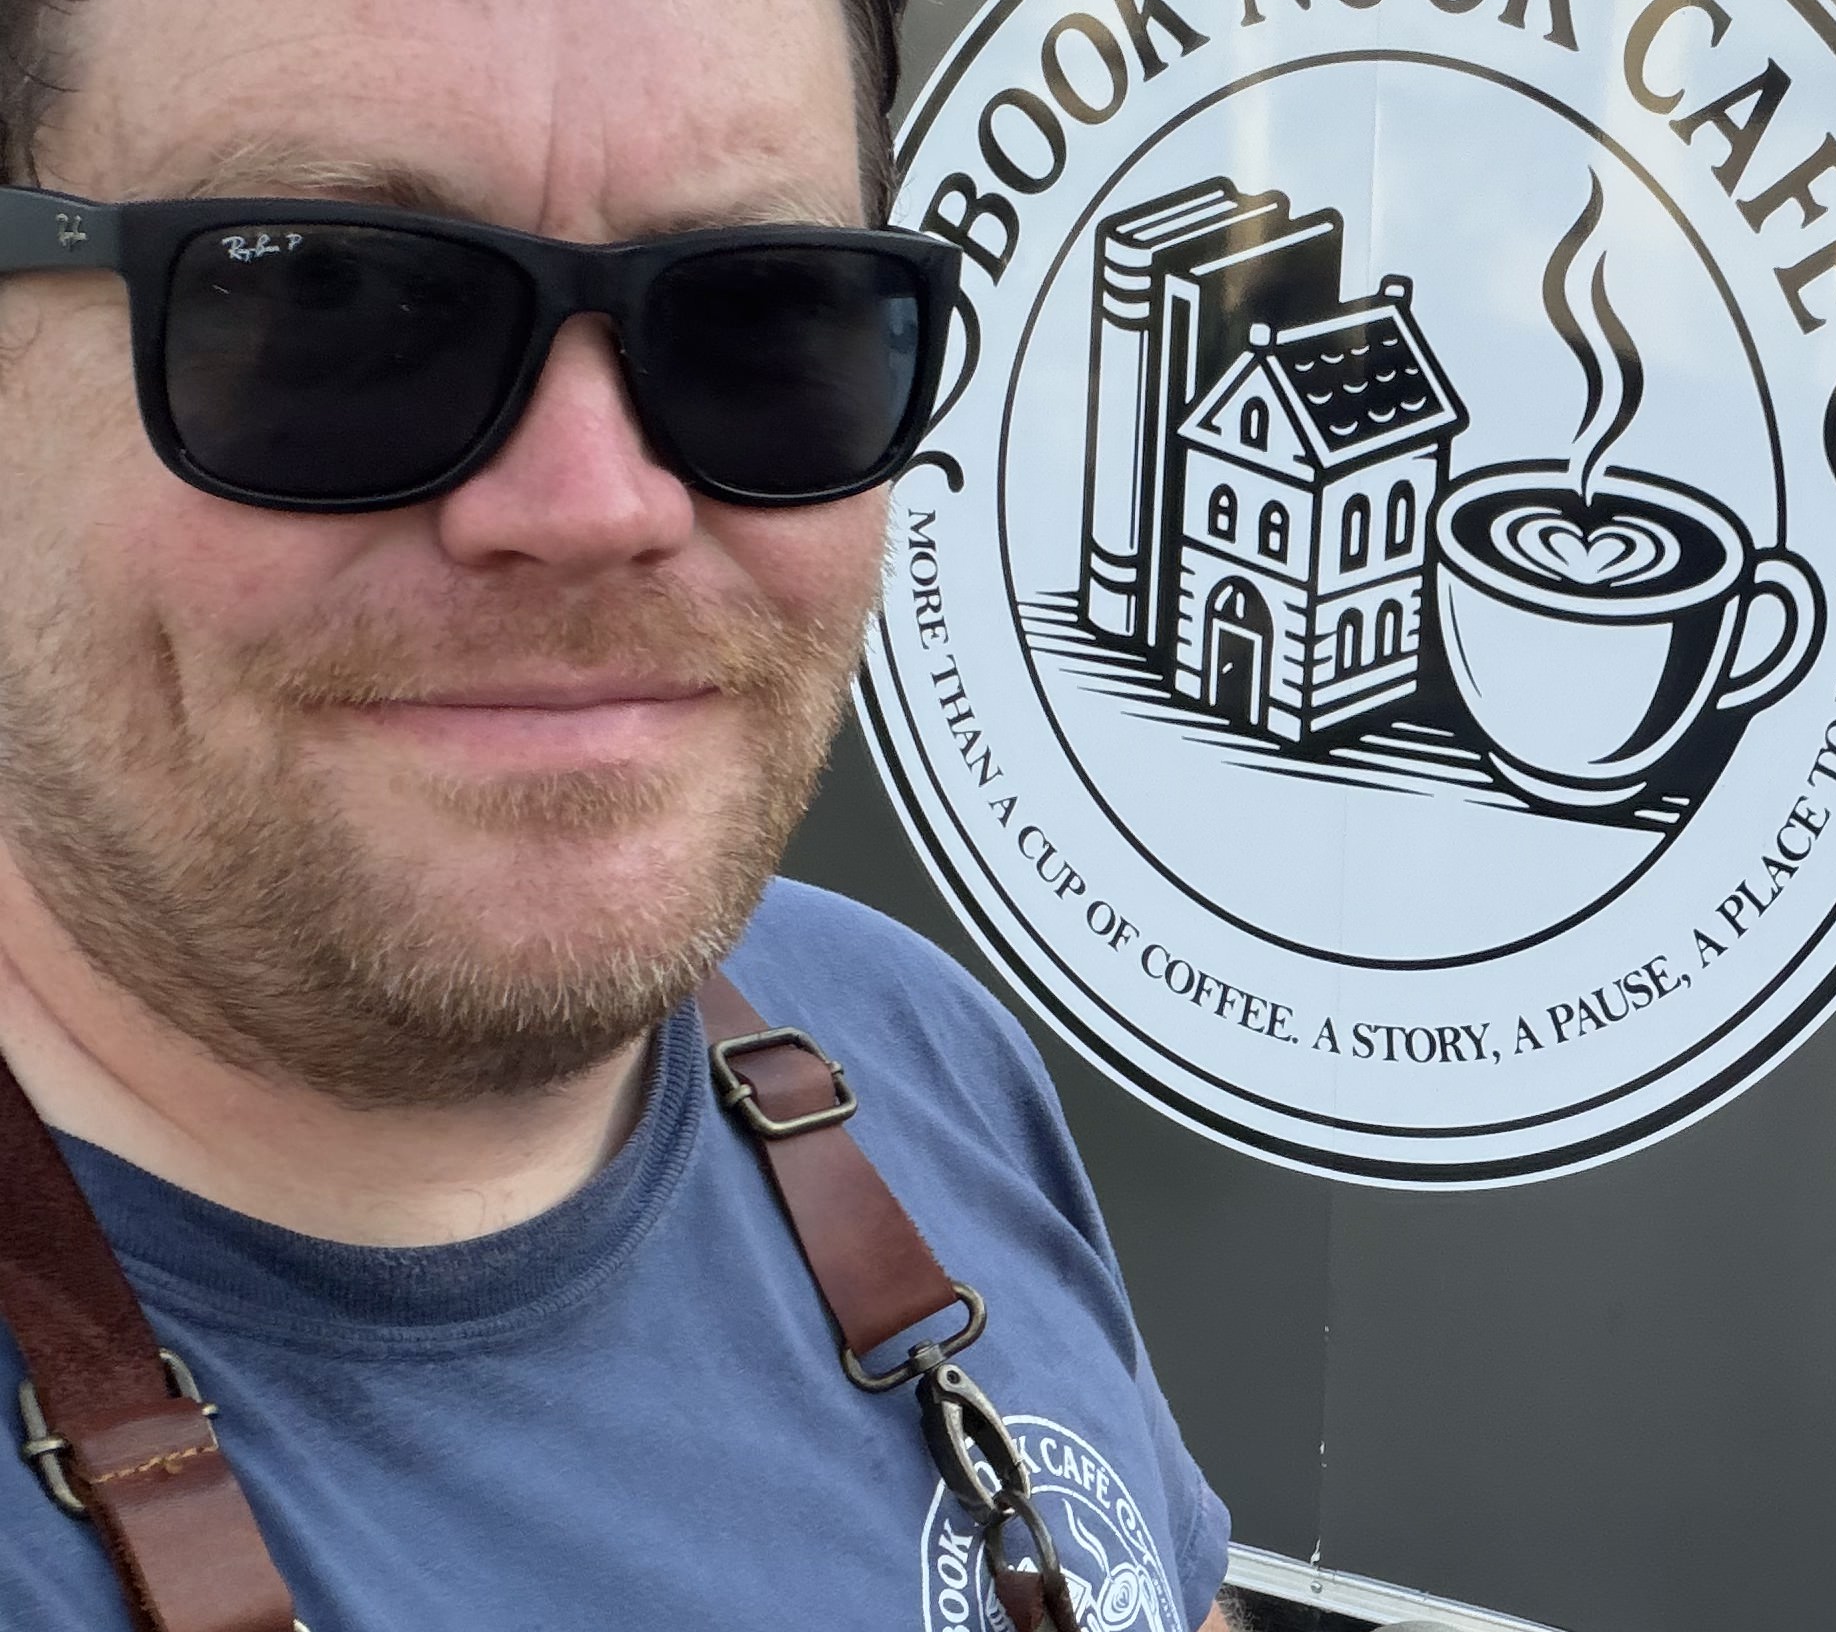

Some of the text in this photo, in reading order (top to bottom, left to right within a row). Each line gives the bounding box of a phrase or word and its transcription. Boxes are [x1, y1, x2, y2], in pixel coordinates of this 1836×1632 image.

[908, 508, 950, 650] MORE
[929, 653, 1005, 788] THAN
[987, 795, 1019, 829] A
[1017, 825, 1087, 900] CUP
[1086, 900, 1141, 953] OF
[1140, 943, 1300, 1045] COFFEE.
[1310, 1016, 1342, 1055] A
[1352, 1022, 1501, 1065] STORY,
[1513, 1015, 1545, 1055] A
[1545, 954, 1692, 1045] PAUSE,
[1692, 928, 1729, 970] A
[1714, 795, 1831, 940] PLACE
[1039, 1436, 1112, 1510] CAFÉ
